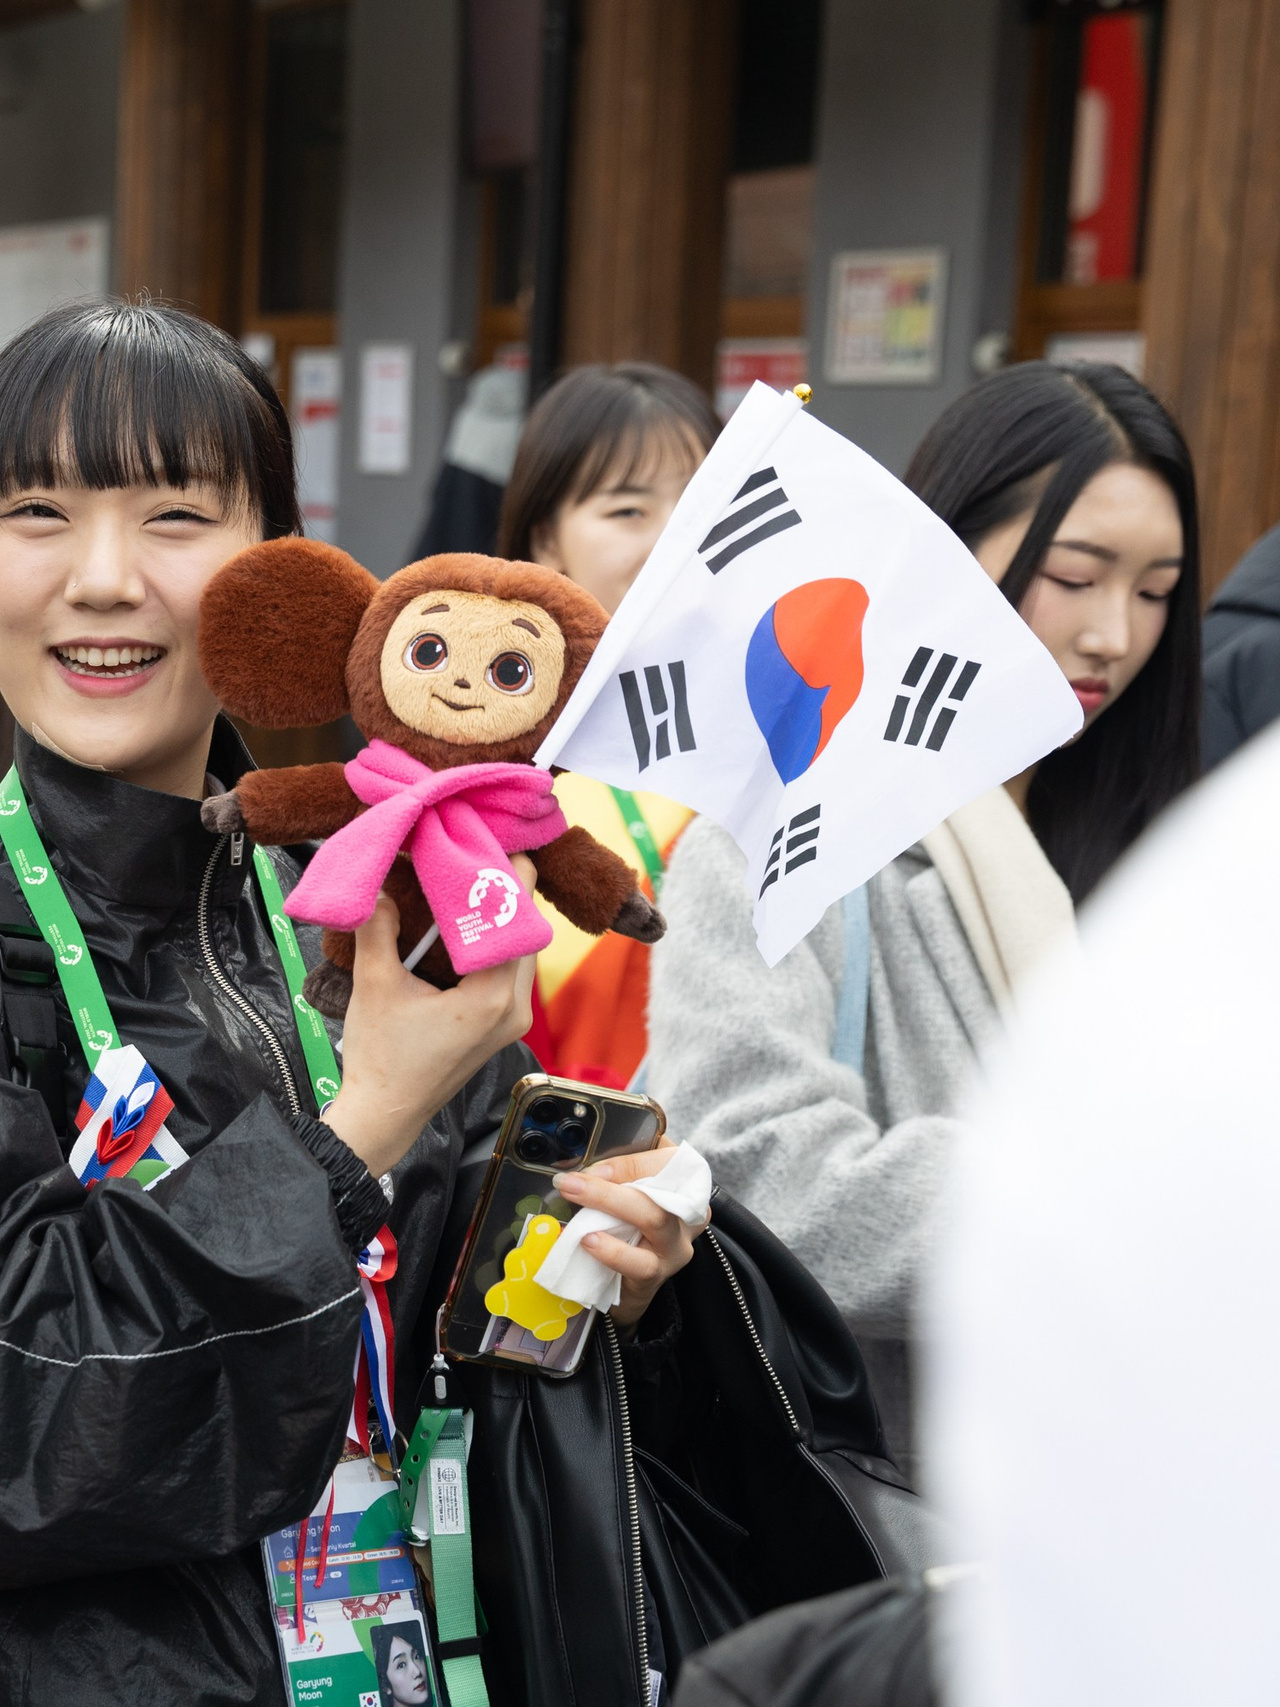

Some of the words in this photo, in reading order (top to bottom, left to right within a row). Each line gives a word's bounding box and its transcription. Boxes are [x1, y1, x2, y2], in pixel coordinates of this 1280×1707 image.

[456, 911, 481, 925] WORLD
[458, 918, 483, 932] YOUTH
[52, 923, 61, 939] WORLD
[461, 922, 493, 938] FESTIVAL
[77, 1009, 89, 1029] FESTIVAL
[84, 1029, 92, 1040] 2024
[82, 1007, 91, 1023] WORLD
[88, 1023, 97, 1038] YOUTH
[286, 1527, 316, 1539] Garyng
[317, 1523, 341, 1533] Mon
[297, 1677, 332, 1690] Garyung
[299, 1691, 322, 1701] Moon
